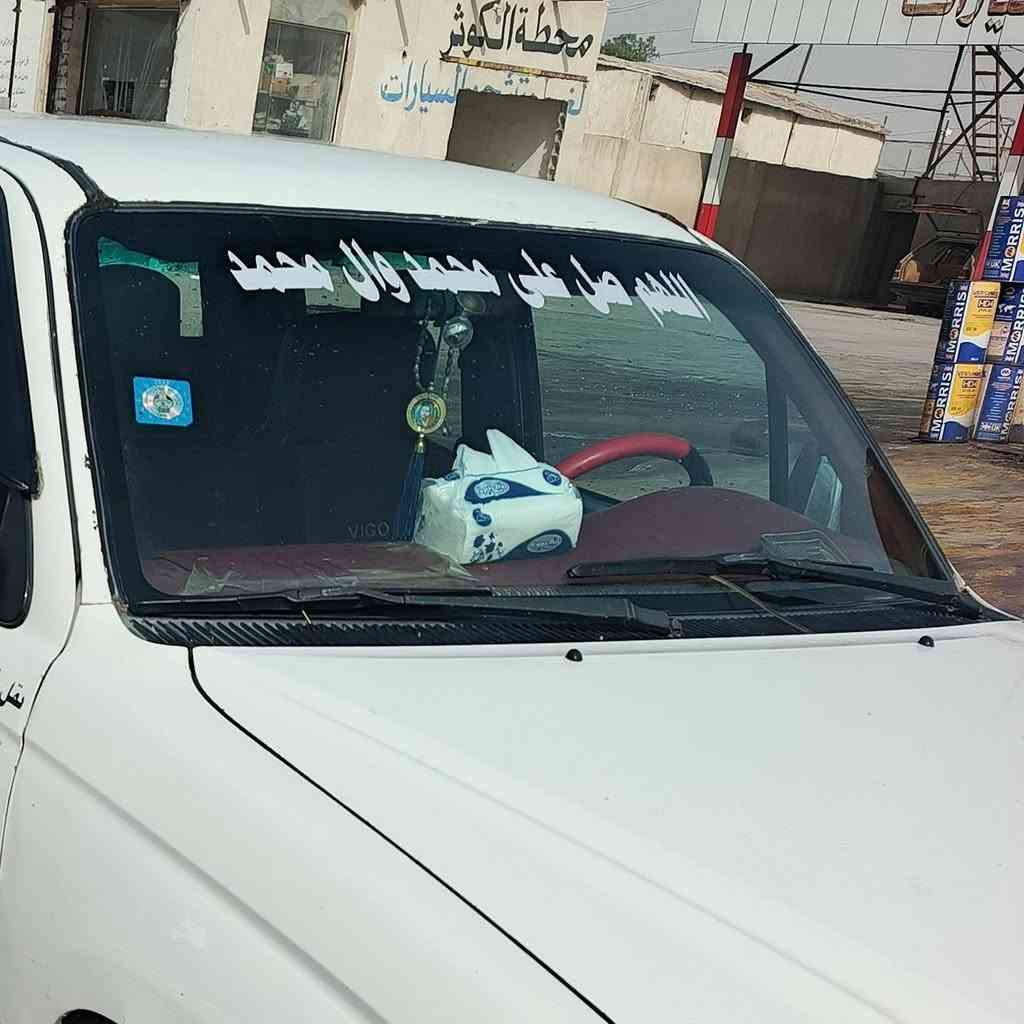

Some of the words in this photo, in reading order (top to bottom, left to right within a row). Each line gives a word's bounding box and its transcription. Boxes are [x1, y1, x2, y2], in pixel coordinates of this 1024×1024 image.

[440, 0, 518, 58] الكوثر
[516, 2, 594, 58] محطة
[228, 250, 334, 293] محمد
[339, 238, 411, 304] وال
[403, 250, 501, 296] محمد
[509, 248, 572, 309] على
[570, 254, 633, 314] صل
[635, 270, 711, 327] اللهم
[946, 291, 967, 353] MORRIS
[933, 371, 952, 432] MORRIS
[344, 520, 391, 538] VIGO
